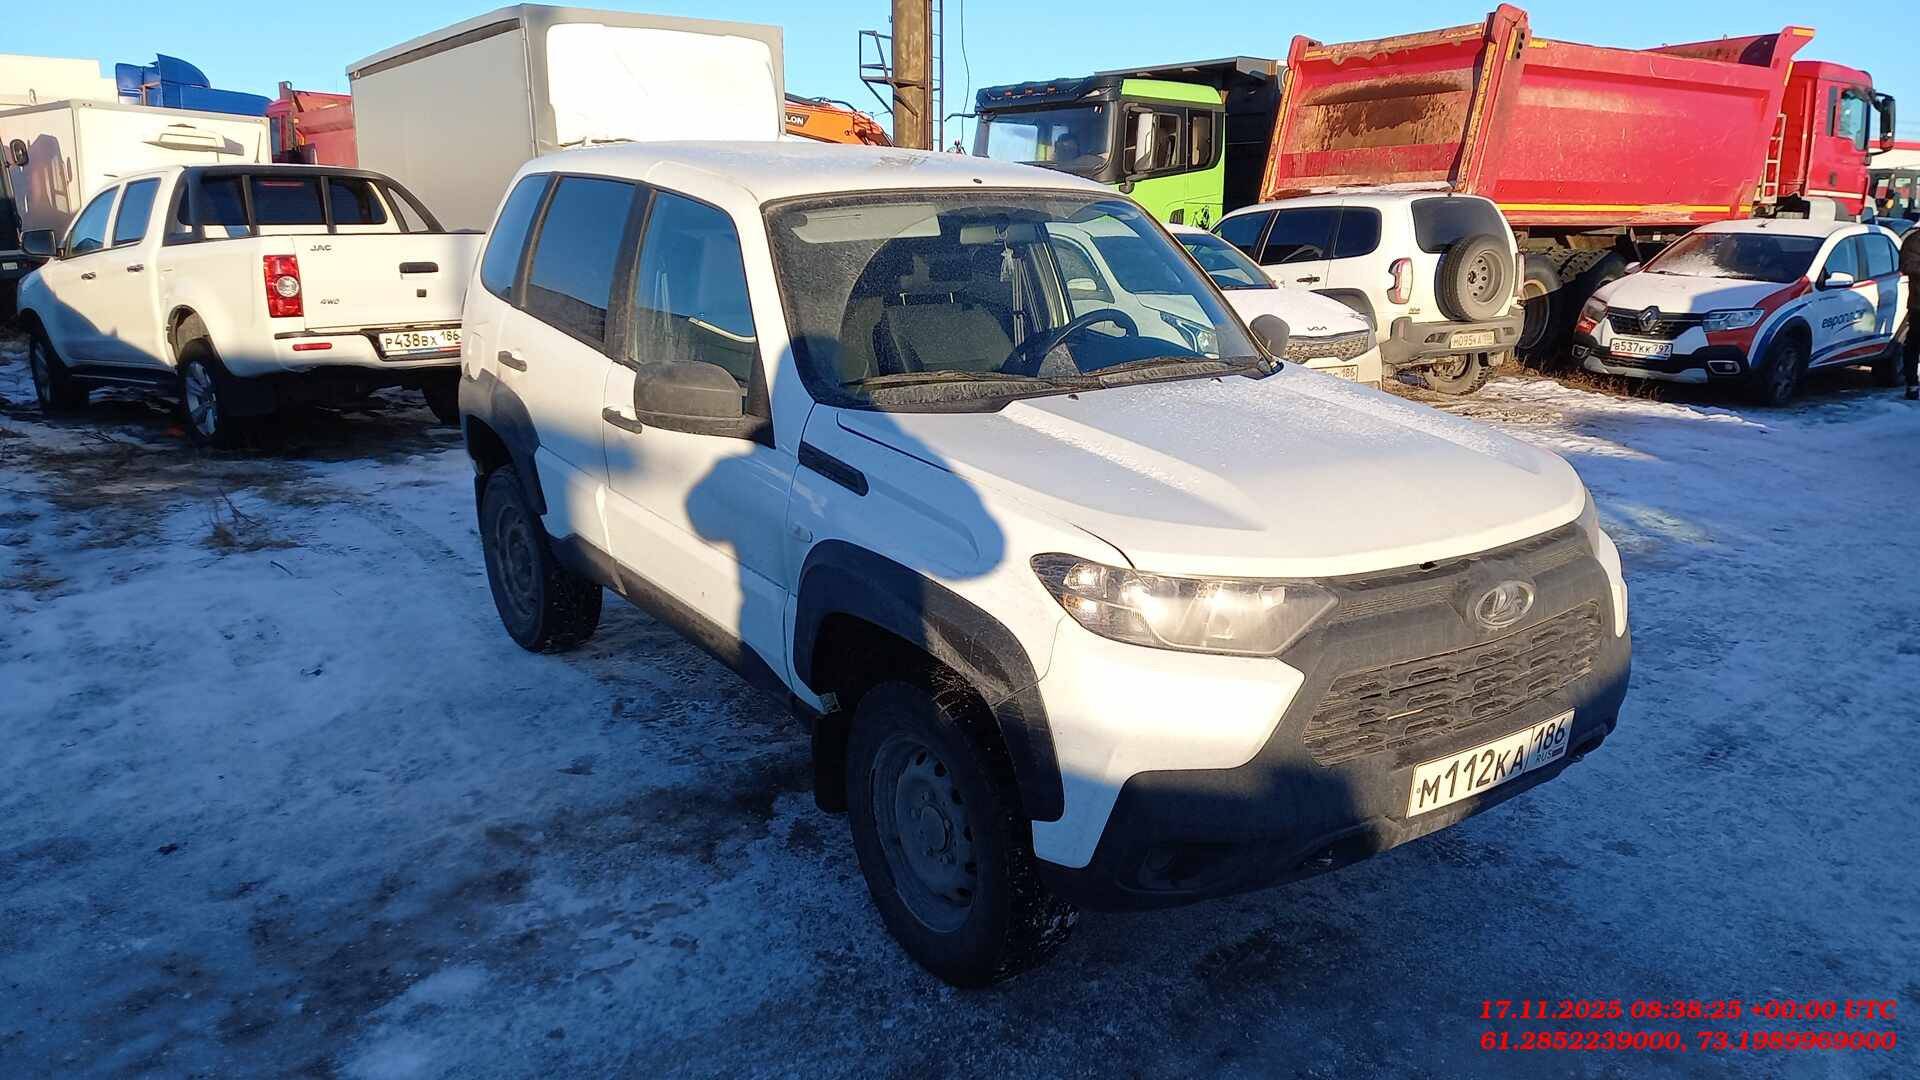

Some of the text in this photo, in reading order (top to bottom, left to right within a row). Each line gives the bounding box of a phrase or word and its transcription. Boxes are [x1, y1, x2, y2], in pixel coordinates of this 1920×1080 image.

[310, 244, 332, 252] JAC
[1536, 750, 1552, 762] RUS
[1418, 716, 1567, 809] М112КА 186
